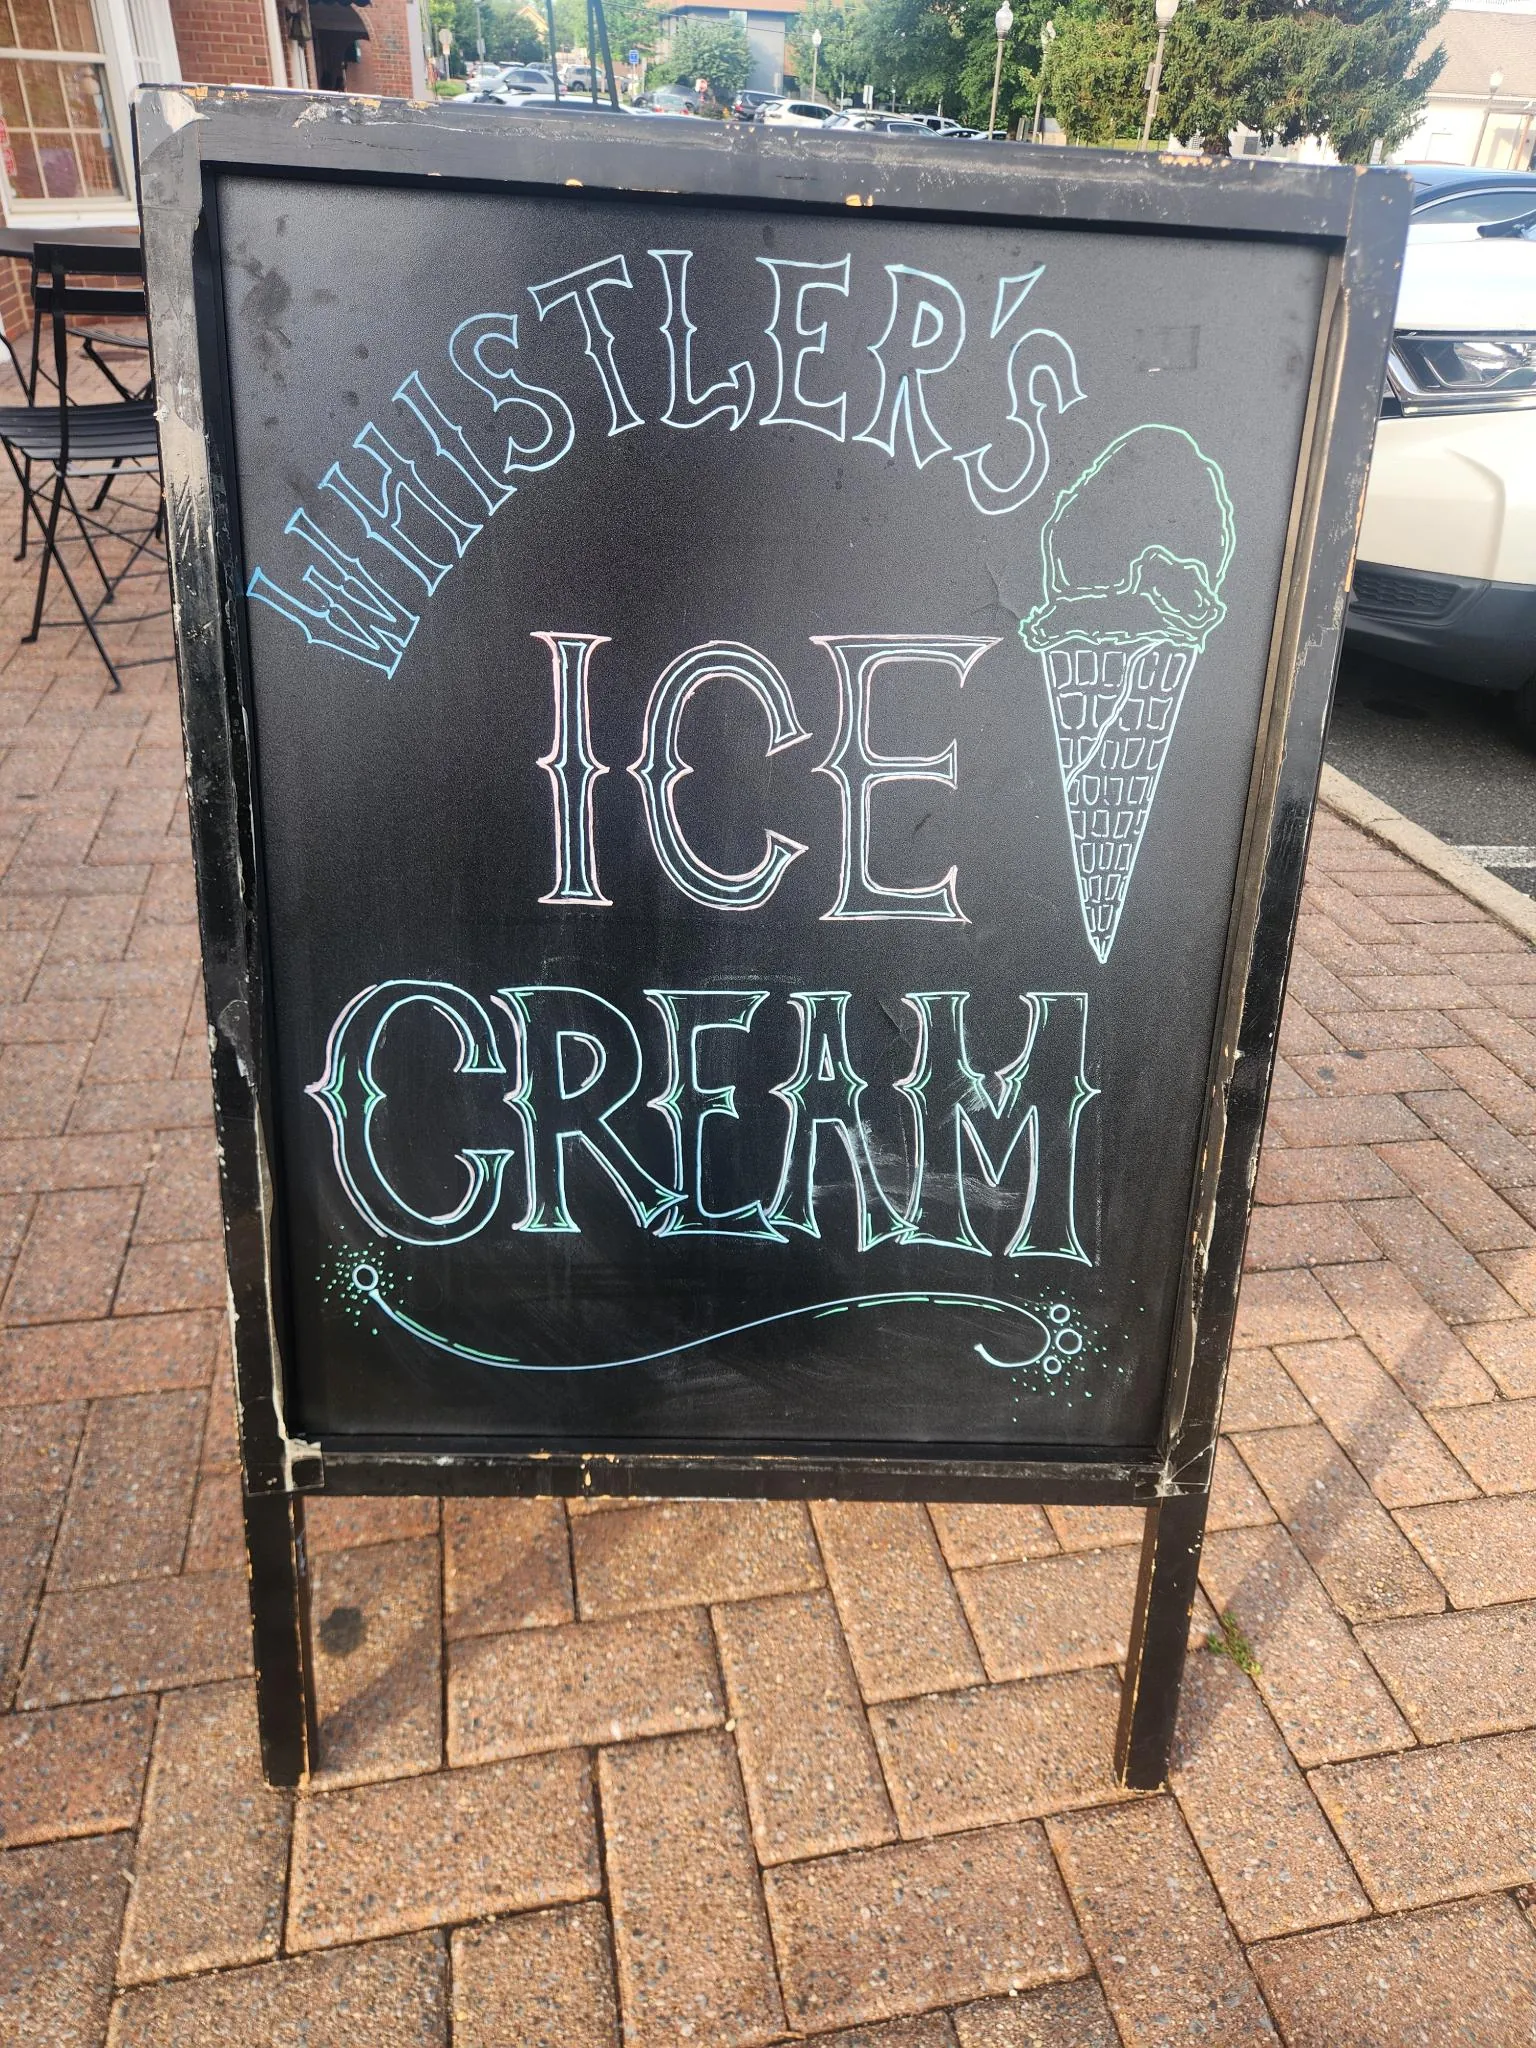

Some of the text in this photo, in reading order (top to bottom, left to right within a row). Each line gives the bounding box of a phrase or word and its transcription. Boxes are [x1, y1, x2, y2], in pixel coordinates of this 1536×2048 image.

[247, 249, 1087, 680] WHISTLER'S
[530, 631, 1004, 924] ICE
[305, 979, 1101, 1267] CREAM
